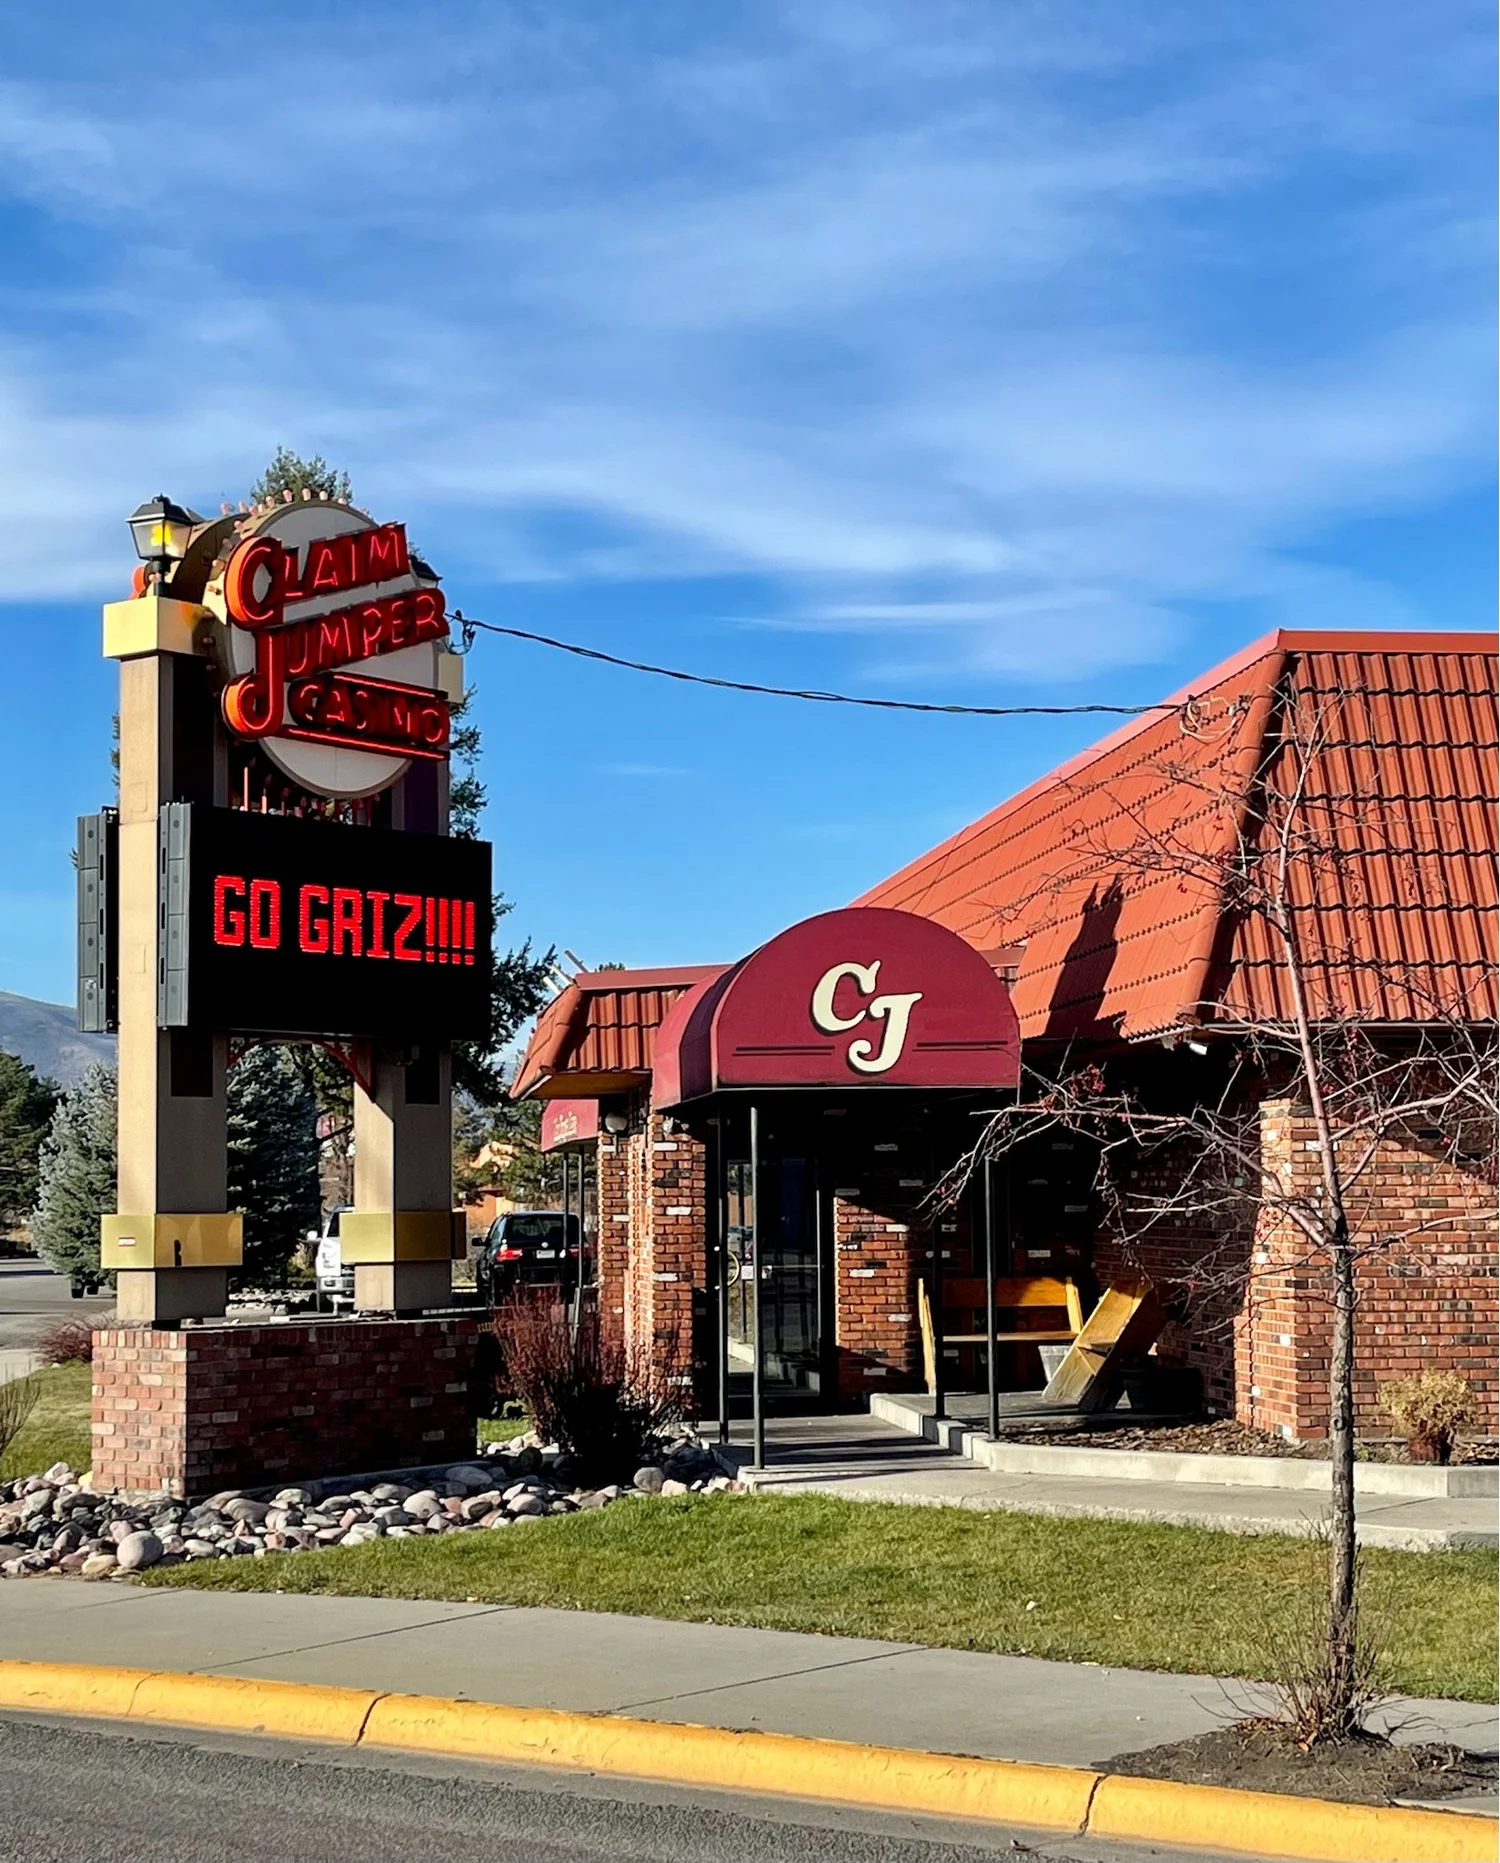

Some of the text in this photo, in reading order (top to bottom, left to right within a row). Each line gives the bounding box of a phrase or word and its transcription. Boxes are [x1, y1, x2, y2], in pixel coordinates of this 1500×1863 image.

[225, 522, 410, 632] CLAIM
[222, 587, 450, 740] JUMPER
[291, 674, 450, 747] CASINO
[213, 875, 475, 966] GO GRIZ!!!!
[810, 959, 924, 1075] CJ
